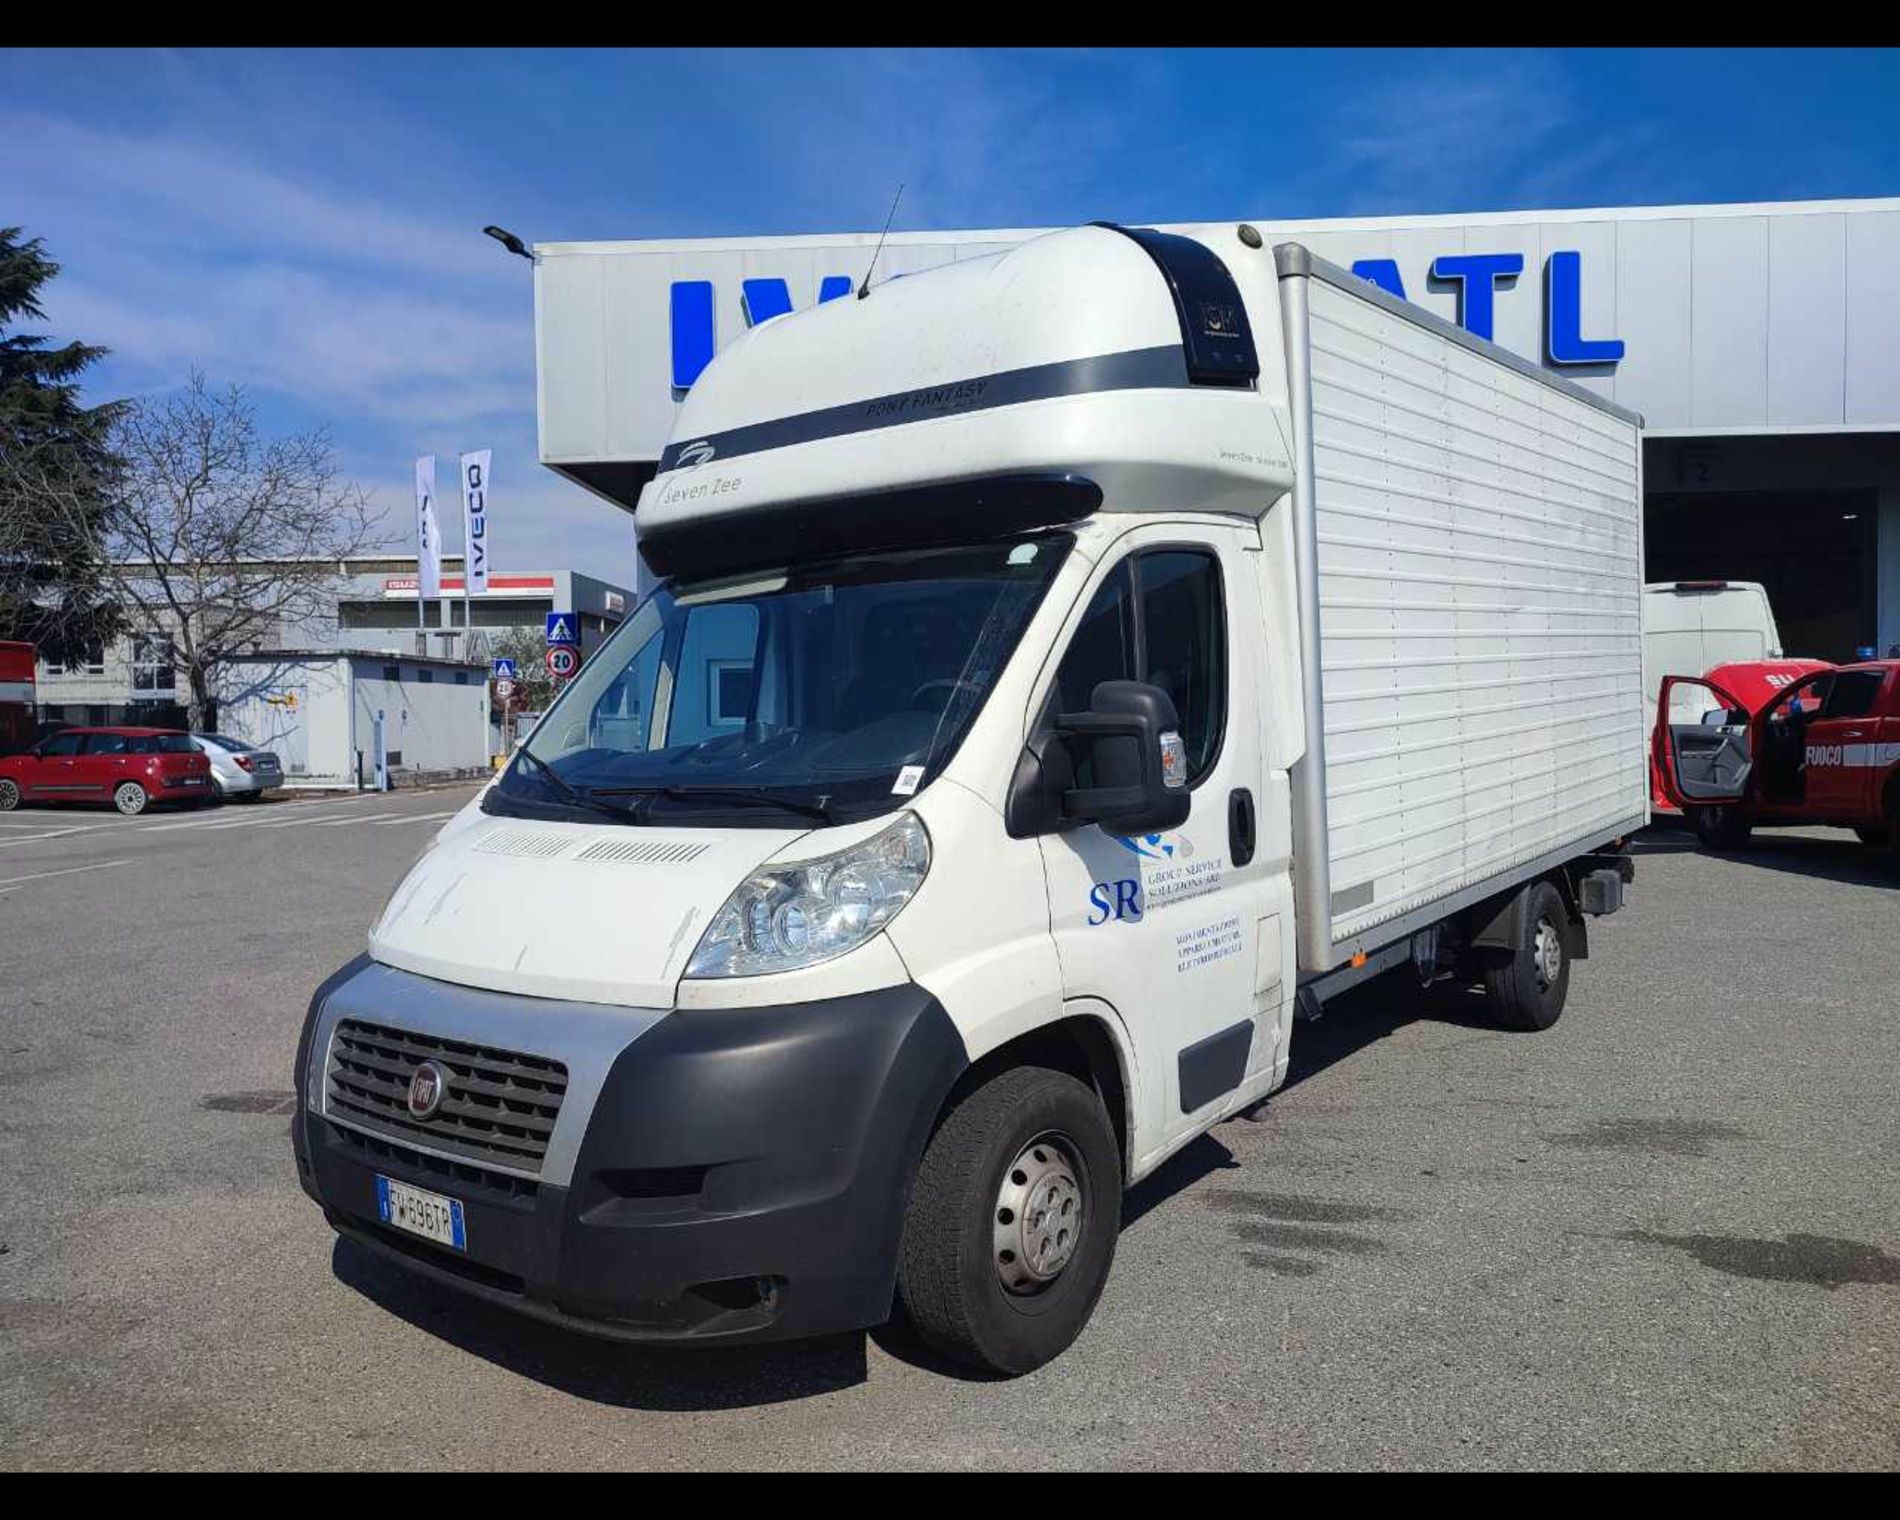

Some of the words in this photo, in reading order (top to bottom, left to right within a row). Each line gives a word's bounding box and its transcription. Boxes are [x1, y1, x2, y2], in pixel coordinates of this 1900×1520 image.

[1352, 251, 1625, 363] TL
[468, 464, 484, 577] IVECO
[388, 581, 420, 589] ISUZ
[553, 654, 571, 669] 20
[1805, 745, 1842, 765] FUOCO
[1088, 879, 1142, 926] SR
[415, 1079, 434, 1104] FIAT
